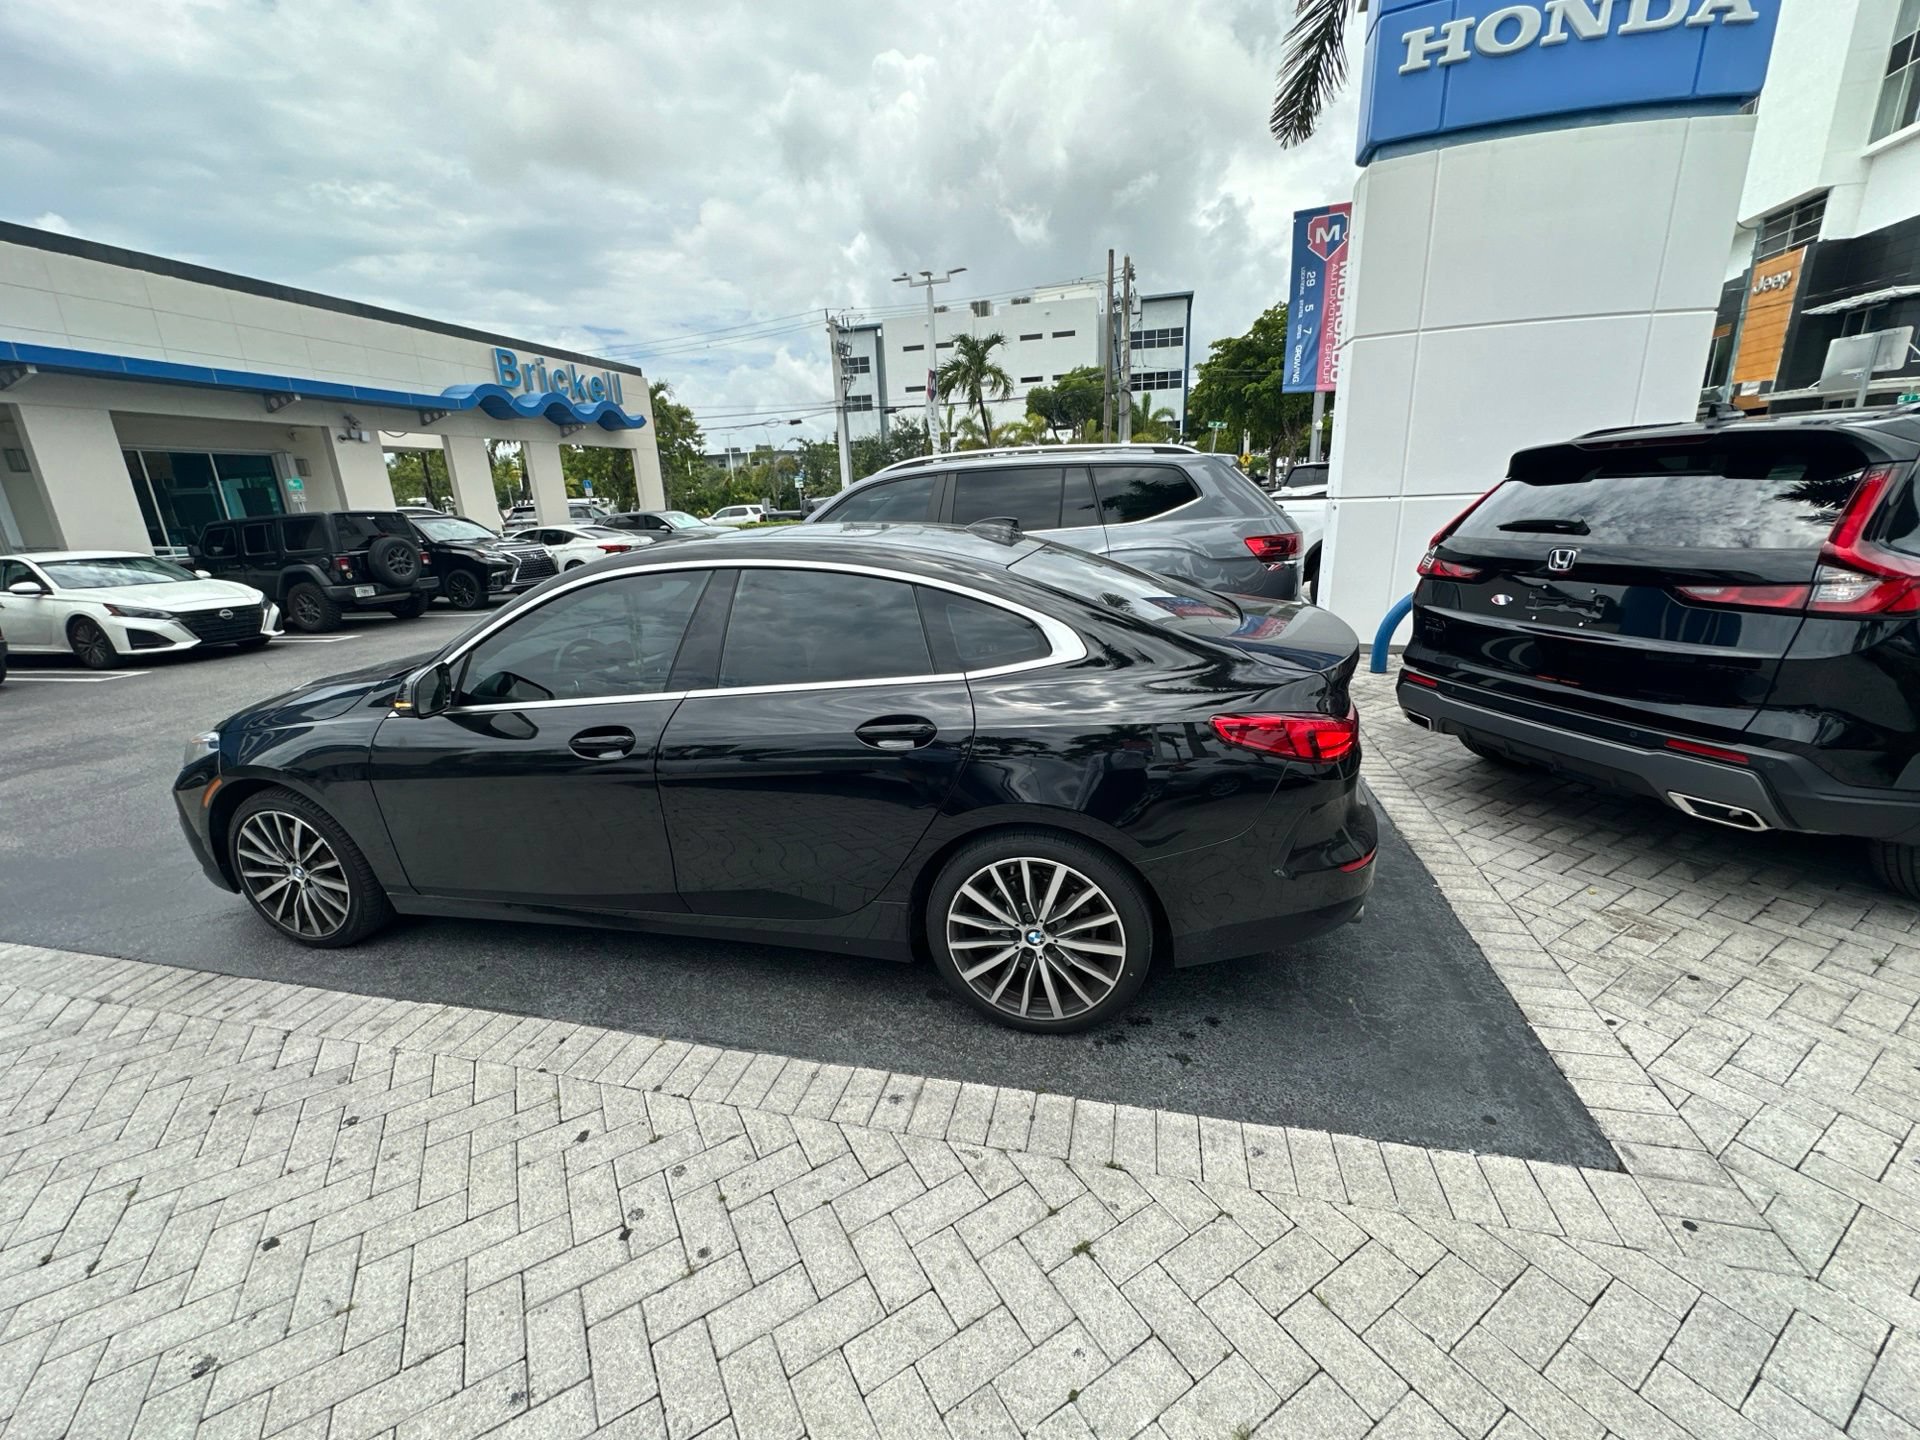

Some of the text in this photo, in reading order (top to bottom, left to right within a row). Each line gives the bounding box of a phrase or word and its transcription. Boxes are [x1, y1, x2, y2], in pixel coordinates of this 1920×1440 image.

[1398, 0, 1759, 75] HONDA
[1315, 224, 1340, 244] M
[1306, 271, 1316, 287] 29
[1752, 270, 1792, 295] Jeep
[1305, 303, 1314, 312] 5
[1323, 263, 1339, 384] AUTOMOTIVE GROUP
[491, 347, 623, 405] Brickell
